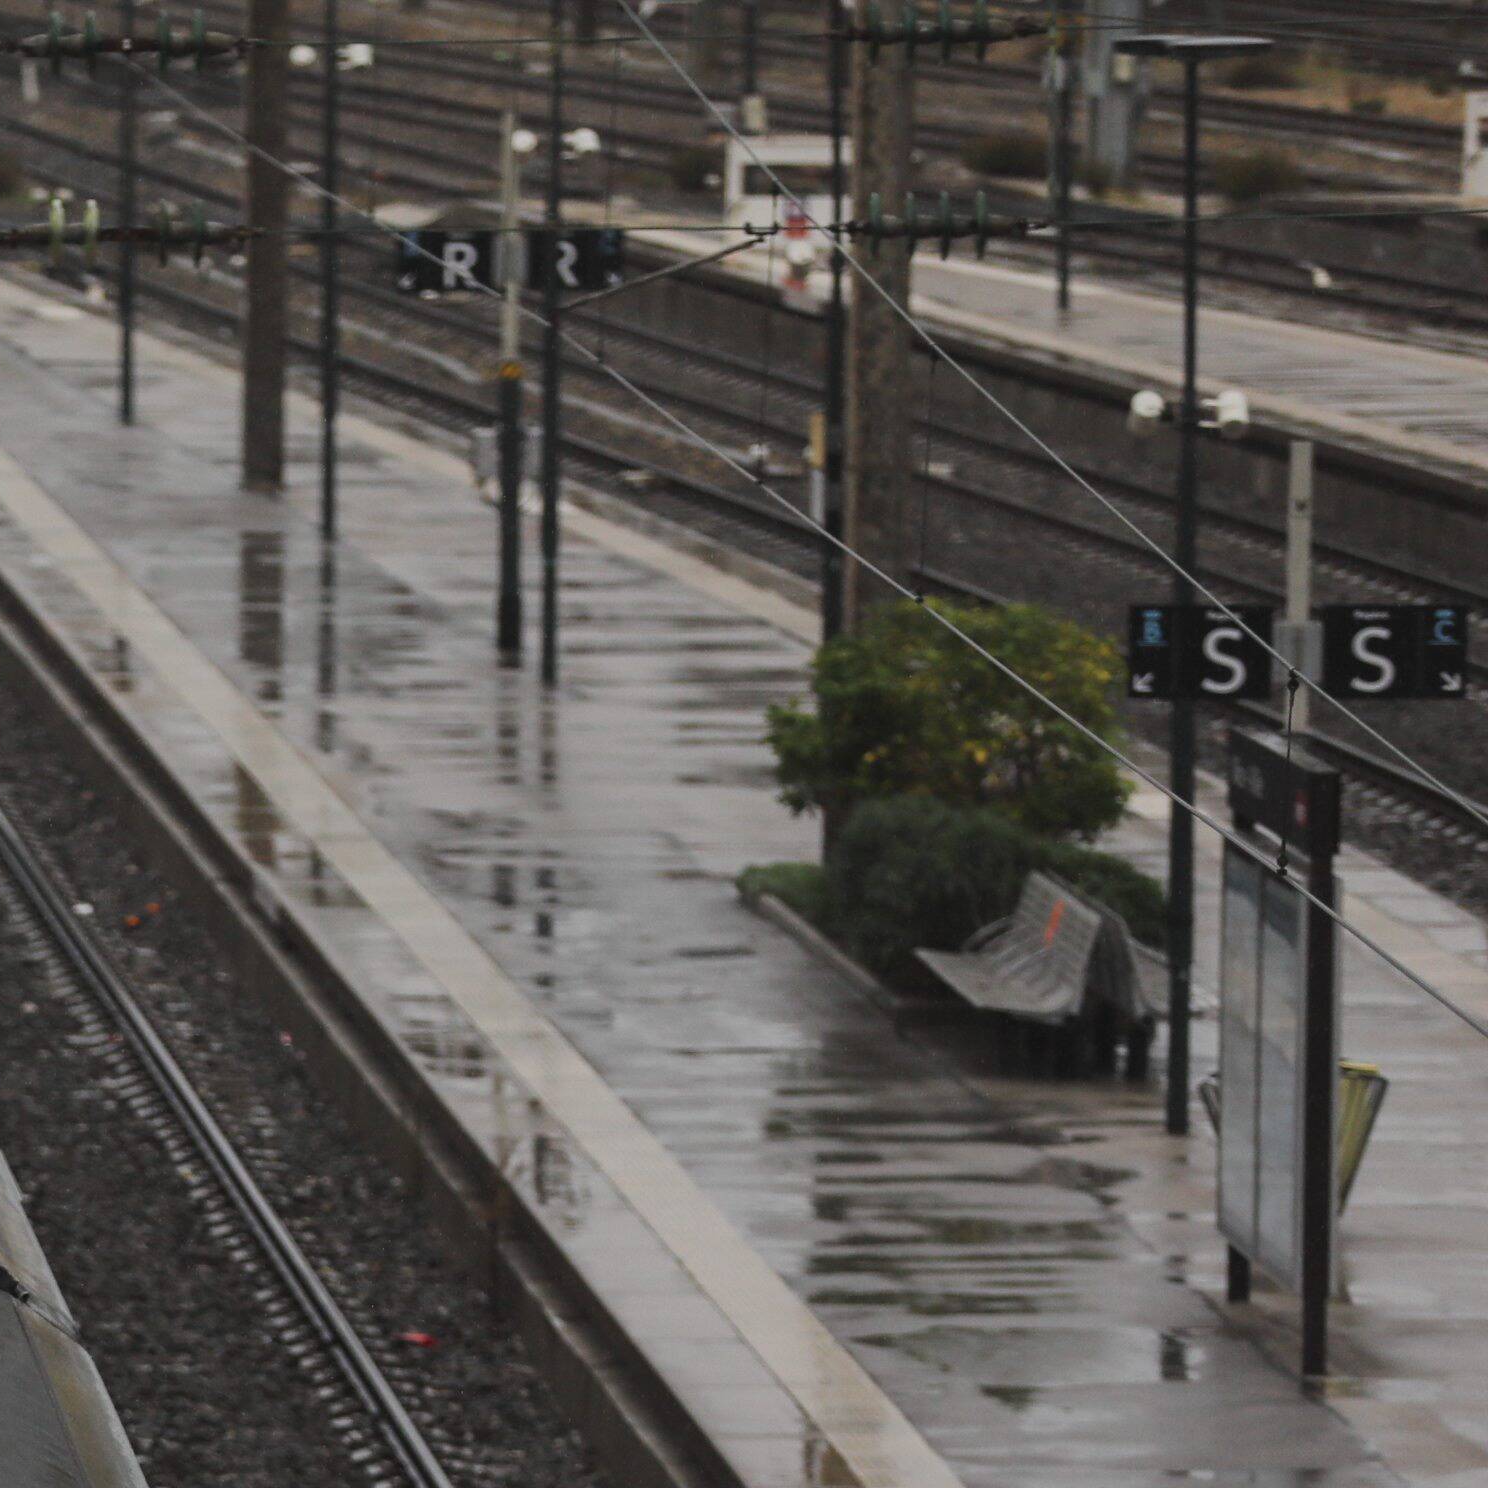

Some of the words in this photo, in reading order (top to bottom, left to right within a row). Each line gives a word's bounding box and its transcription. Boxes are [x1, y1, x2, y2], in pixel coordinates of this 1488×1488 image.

[442, 241, 479, 289] R
[1201, 627, 1248, 694] S
[1350, 627, 1396, 694] S
